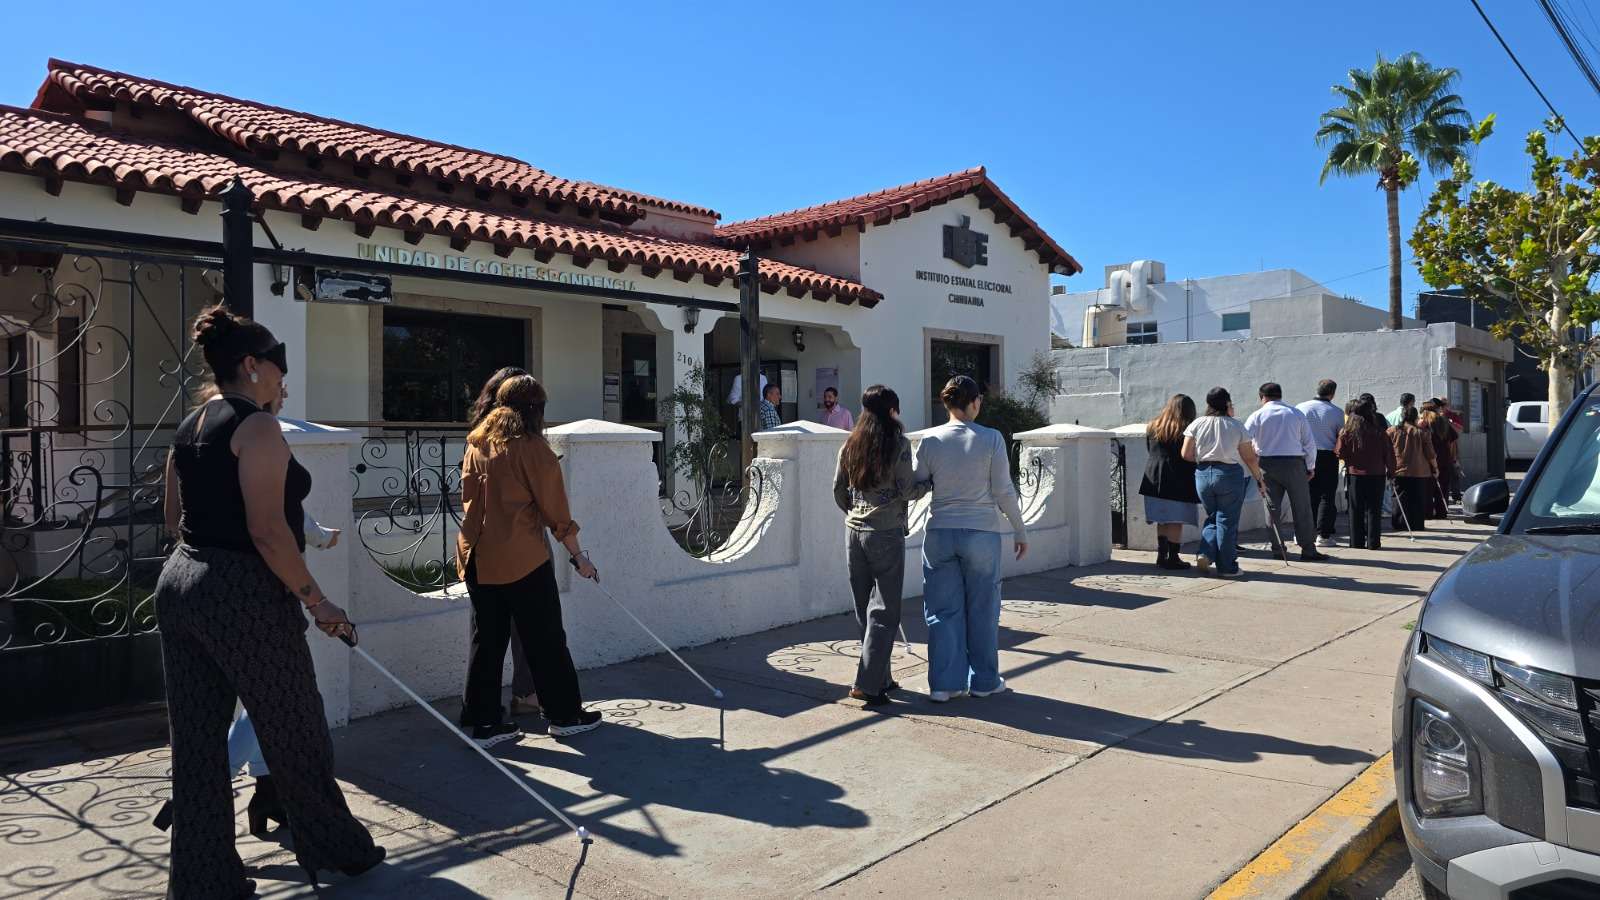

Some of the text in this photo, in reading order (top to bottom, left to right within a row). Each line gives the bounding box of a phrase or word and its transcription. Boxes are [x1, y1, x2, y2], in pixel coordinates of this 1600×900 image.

[358, 243, 638, 291] UNIDAD DE CORRESPONDENCIA
[916, 270, 1012, 294] INSTITUTO ESTATAL ELECTORAL
[949, 294, 985, 307] CHIHUAHUA
[677, 352, 693, 366] 210
